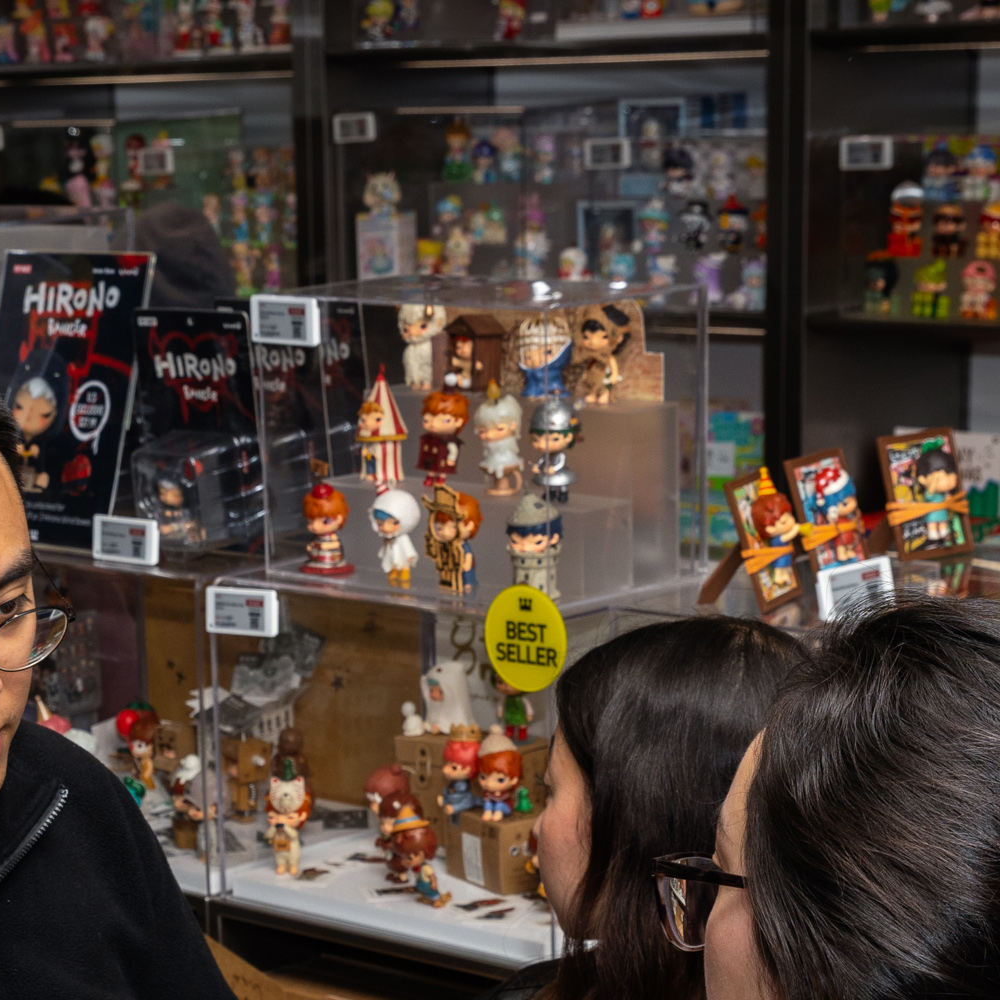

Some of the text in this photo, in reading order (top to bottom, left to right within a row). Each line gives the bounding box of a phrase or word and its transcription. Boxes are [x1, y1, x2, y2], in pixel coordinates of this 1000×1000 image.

[22, 280, 121, 317] HIRONO
[154, 351, 238, 382] HIRONO
[506, 621, 548, 643] BEST
[496, 643, 558, 668] SELLER
